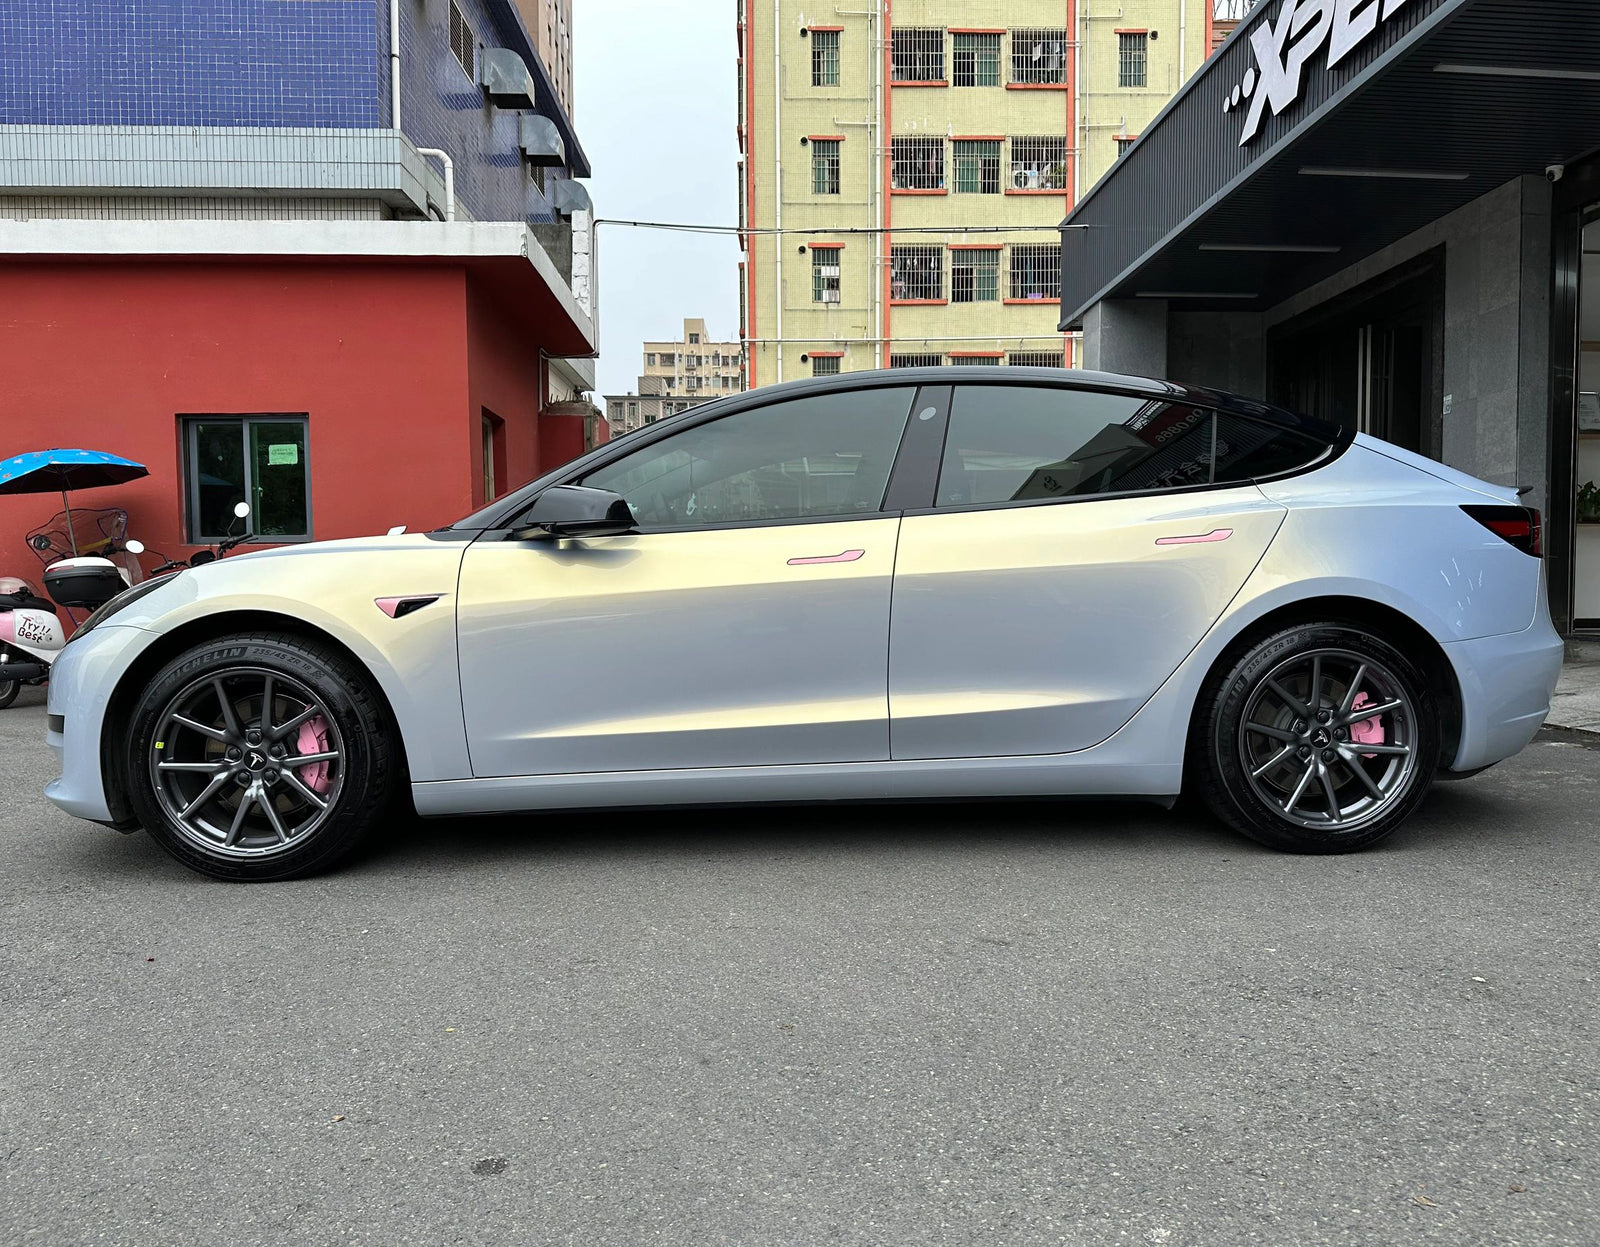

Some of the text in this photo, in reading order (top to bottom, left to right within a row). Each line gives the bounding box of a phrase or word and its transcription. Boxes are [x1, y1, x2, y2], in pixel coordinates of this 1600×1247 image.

[17, 626, 43, 644] Best
[1274, 641, 1285, 652] ZR
[164, 647, 313, 685] MICHELIN 235/45 ZR 18
